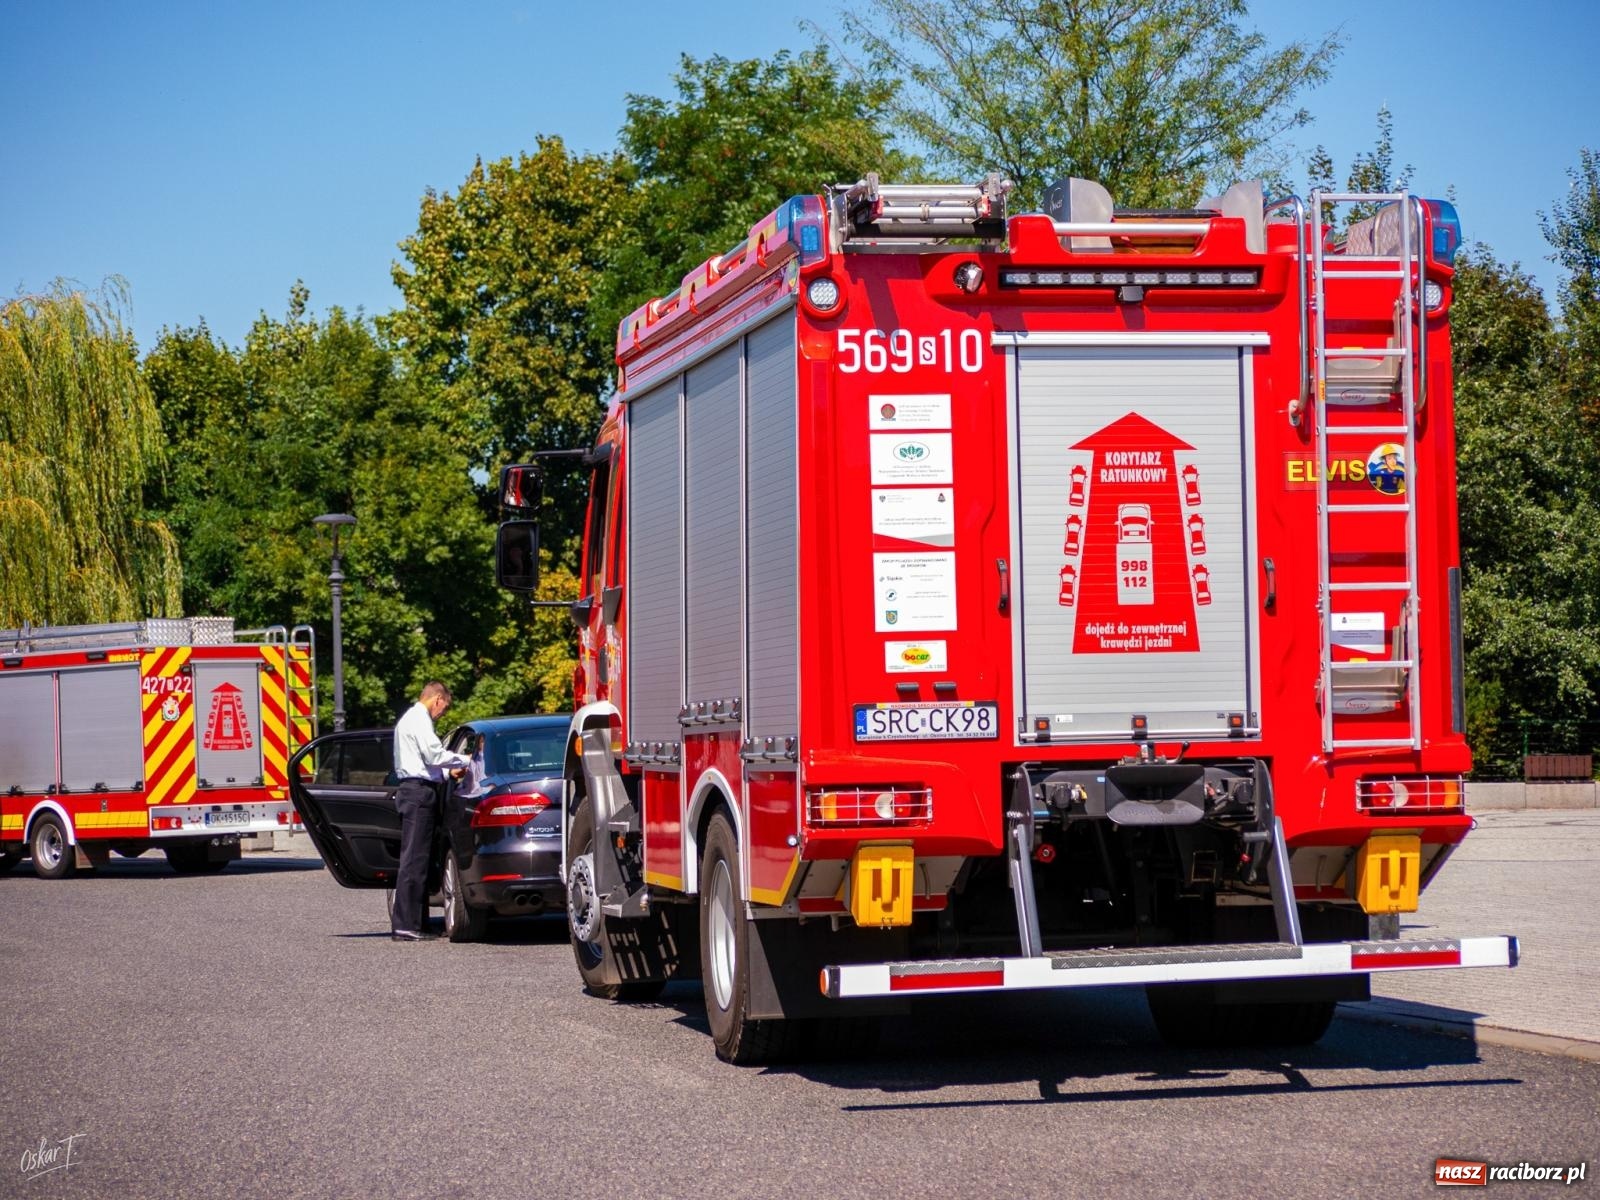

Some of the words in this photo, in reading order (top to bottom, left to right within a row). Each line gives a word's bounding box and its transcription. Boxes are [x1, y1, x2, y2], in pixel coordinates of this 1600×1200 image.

[837, 328, 913, 373] 569
[939, 328, 983, 373] 10
[1105, 451, 1162, 466] KORYTARZ
[1100, 467, 1167, 483] RATUNKOWY
[1287, 459, 1366, 482] ELVIS
[1121, 560, 1148, 571] 998
[1123, 576, 1147, 587] 112
[1117, 622, 1129, 634] do
[1131, 621, 1187, 635] zewnętrznej
[1100, 638, 1142, 651] krawędzi
[1144, 637, 1172, 651] jezdni
[142, 676, 166, 694] 427
[174, 675, 191, 693] 22
[872, 709, 920, 733] SRC
[929, 707, 990, 732] CK98
